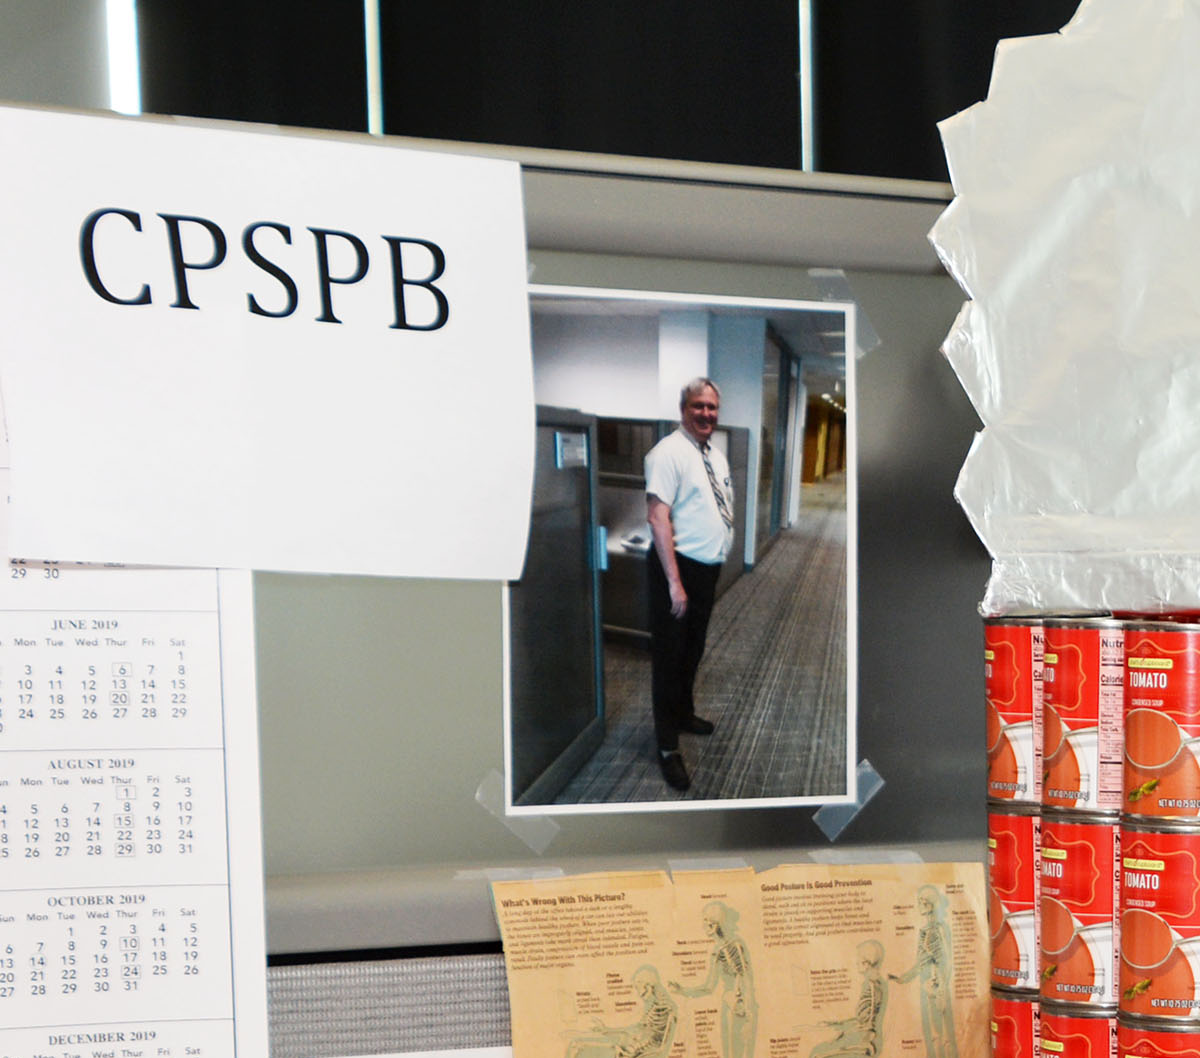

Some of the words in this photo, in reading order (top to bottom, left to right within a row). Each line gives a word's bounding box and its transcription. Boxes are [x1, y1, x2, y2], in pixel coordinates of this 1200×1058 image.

[78, 207, 450, 331] CPSPB
[51, 620, 87, 630] JUNE
[92, 620, 118, 630] 2019
[1129, 671, 1167, 689] TOMATO
[48, 759, 103, 770] AUGUST
[108, 759, 135, 769] 2019
[761, 883, 779, 892] Good
[780, 882, 805, 891] Posture
[815, 880, 833, 889] Good
[834, 878, 872, 888] Prevention
[1124, 871, 1160, 890] TOMATO
[47, 895, 114, 907] OCTOBER
[119, 894, 146, 905] 2019
[501, 899, 530, 908] What's
[530, 898, 557, 907] Wrong
[558, 895, 576, 904] With
[577, 894, 593, 903] This
[594, 892, 626, 901] Picture?
[49, 1032, 125, 1046] DECEMBER
[130, 1031, 156, 1042] 2019
[92, 1051, 115, 1058] Wed
[121, 1049, 143, 1058] Thur
[185, 1047, 200, 1055] Sat
